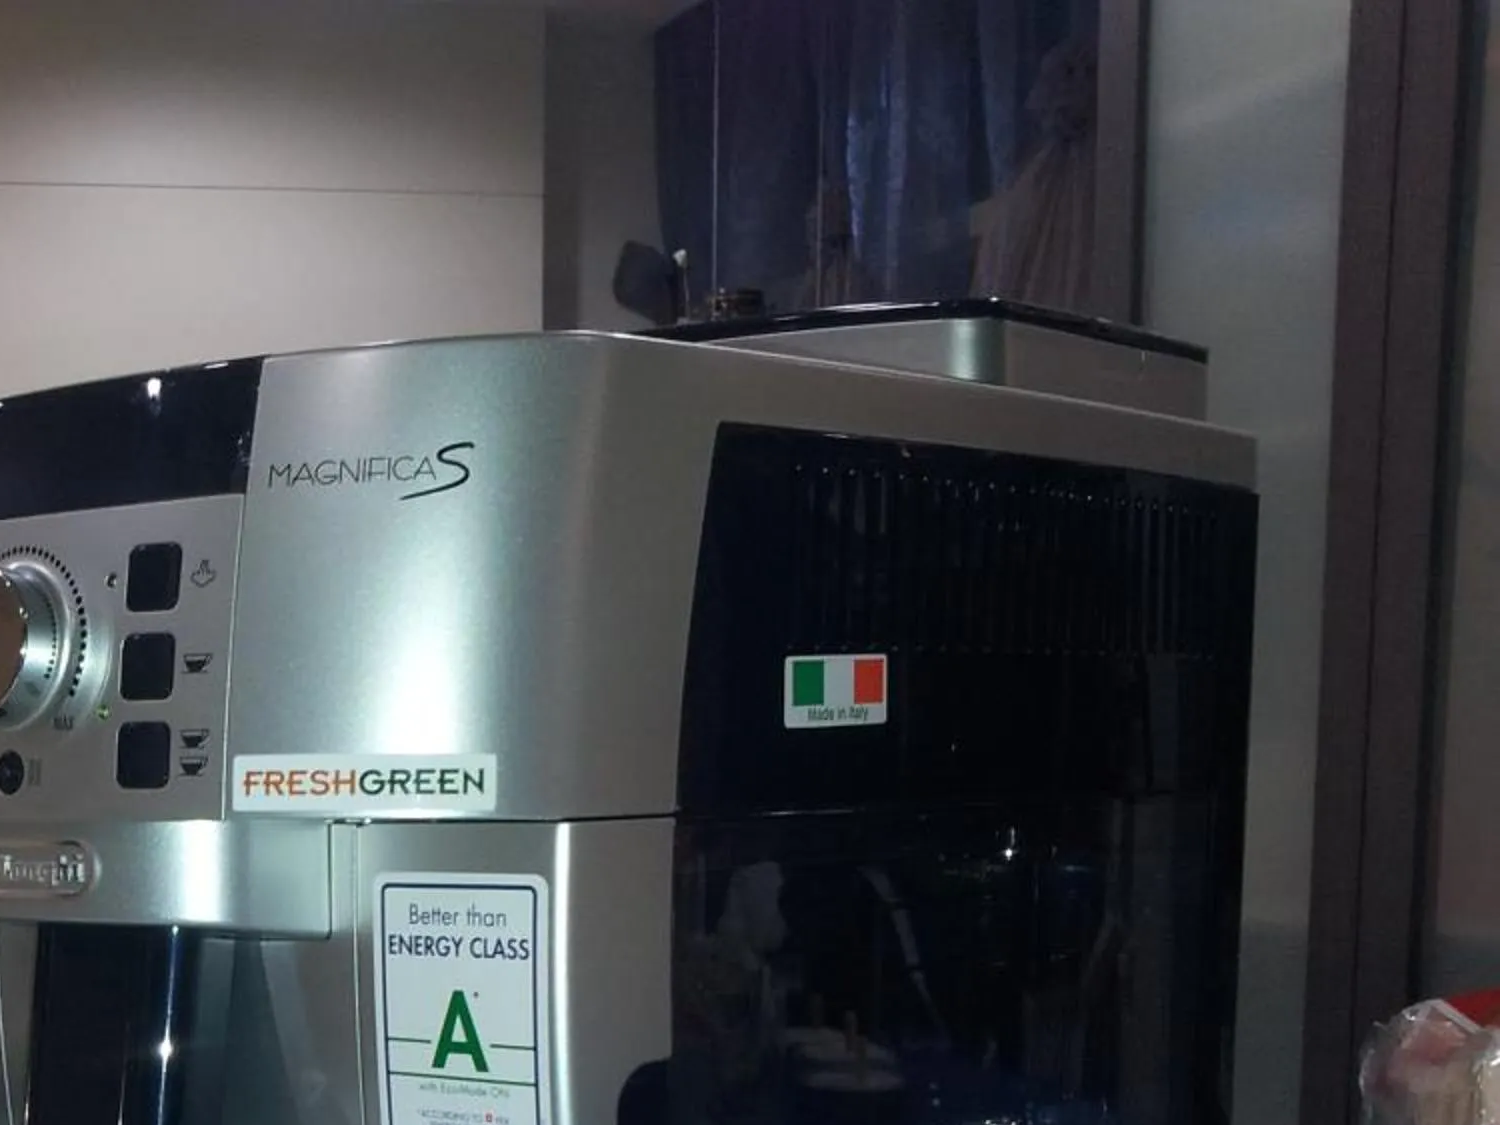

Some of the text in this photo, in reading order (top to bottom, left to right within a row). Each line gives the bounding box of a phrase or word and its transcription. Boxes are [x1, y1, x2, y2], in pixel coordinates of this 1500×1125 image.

[267, 456, 437, 489] MAGNIFICA
[808, 705, 869, 722] Made in Italy
[243, 768, 485, 797] FRESHGREEN
[409, 901, 507, 928] Better than
[388, 934, 530, 961] ENERGY CLASS
